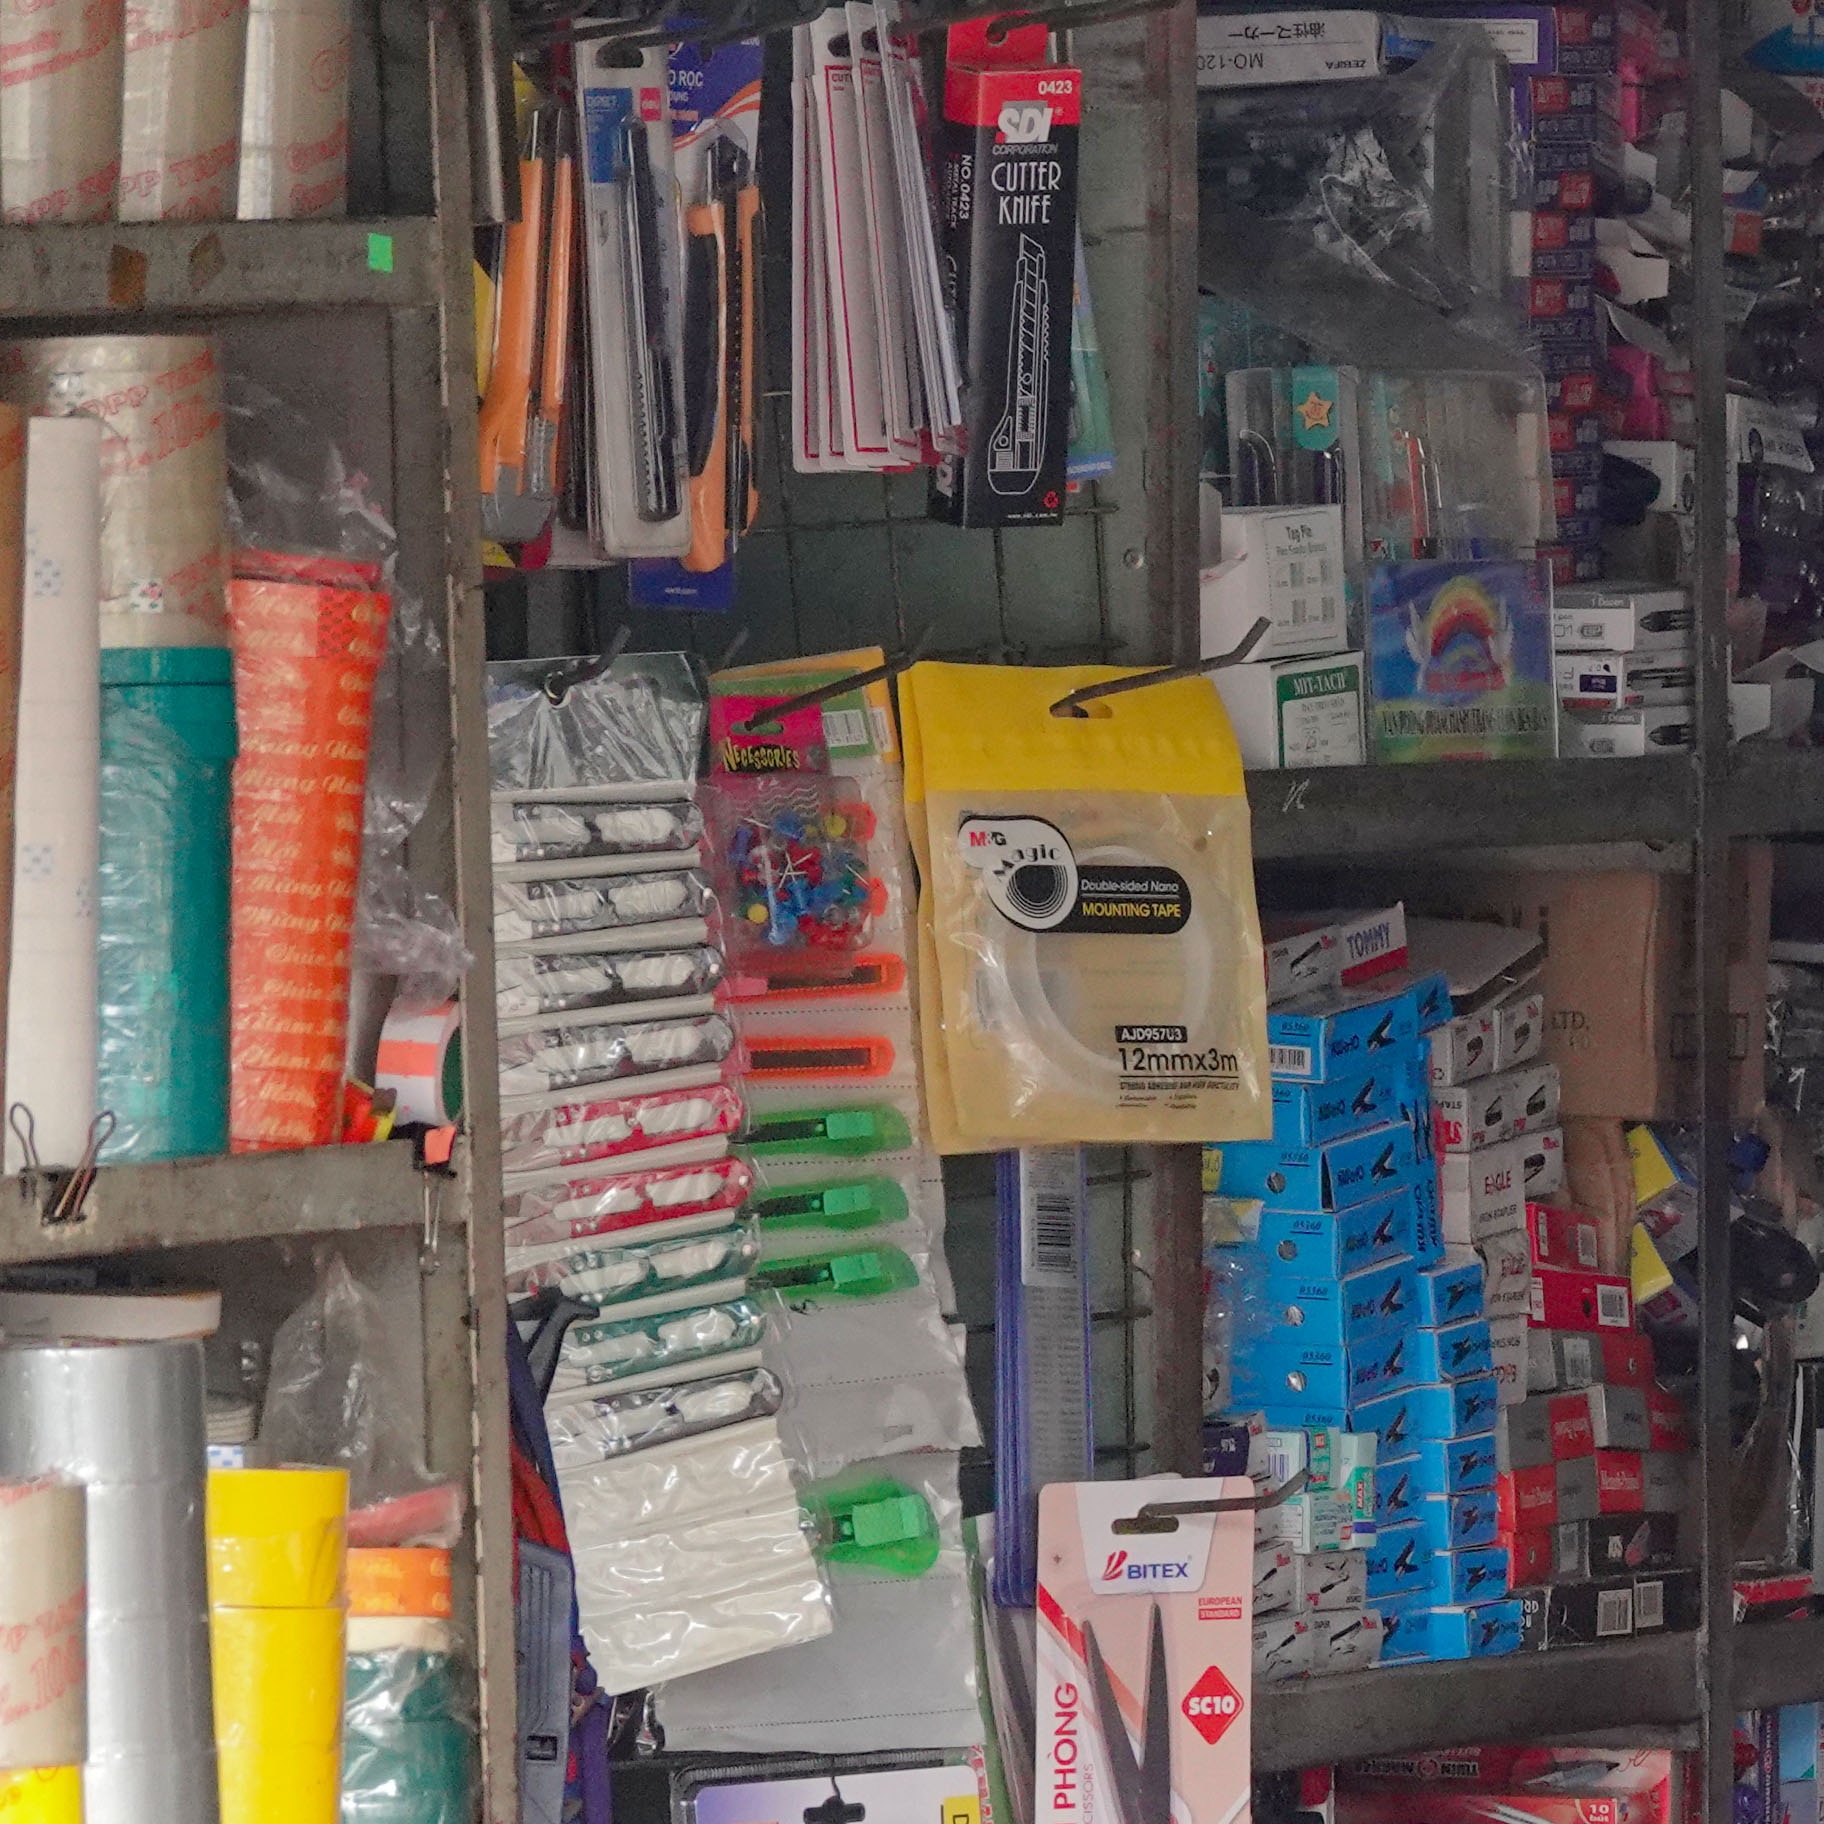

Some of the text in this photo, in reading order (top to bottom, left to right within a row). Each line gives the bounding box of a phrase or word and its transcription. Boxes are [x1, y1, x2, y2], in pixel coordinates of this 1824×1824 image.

[1037, 79, 1073, 95] 0423
[996, 106, 1052, 143] SDI
[992, 143, 1058, 156] CORPORATION
[990, 161, 1061, 192] CUTTER
[998, 195, 1051, 226] KNIFE
[1081, 879, 1179, 892] Double-sided Nano
[1082, 903, 1181, 917] MOUNTING TAPE
[1345, 921, 1391, 960] TOMMY
[1118, 1048, 1238, 1072] 12mmx3m
[1127, 1558, 1189, 1580] BITEX
[1198, 1596, 1242, 1607] EUROPEAN
[1199, 1608, 1241, 1619] STANDARD
[1188, 1695, 1236, 1716] SC10
[1046, 1681, 1079, 1802] PHÒNG
[1588, 1803, 1610, 1815] 10
